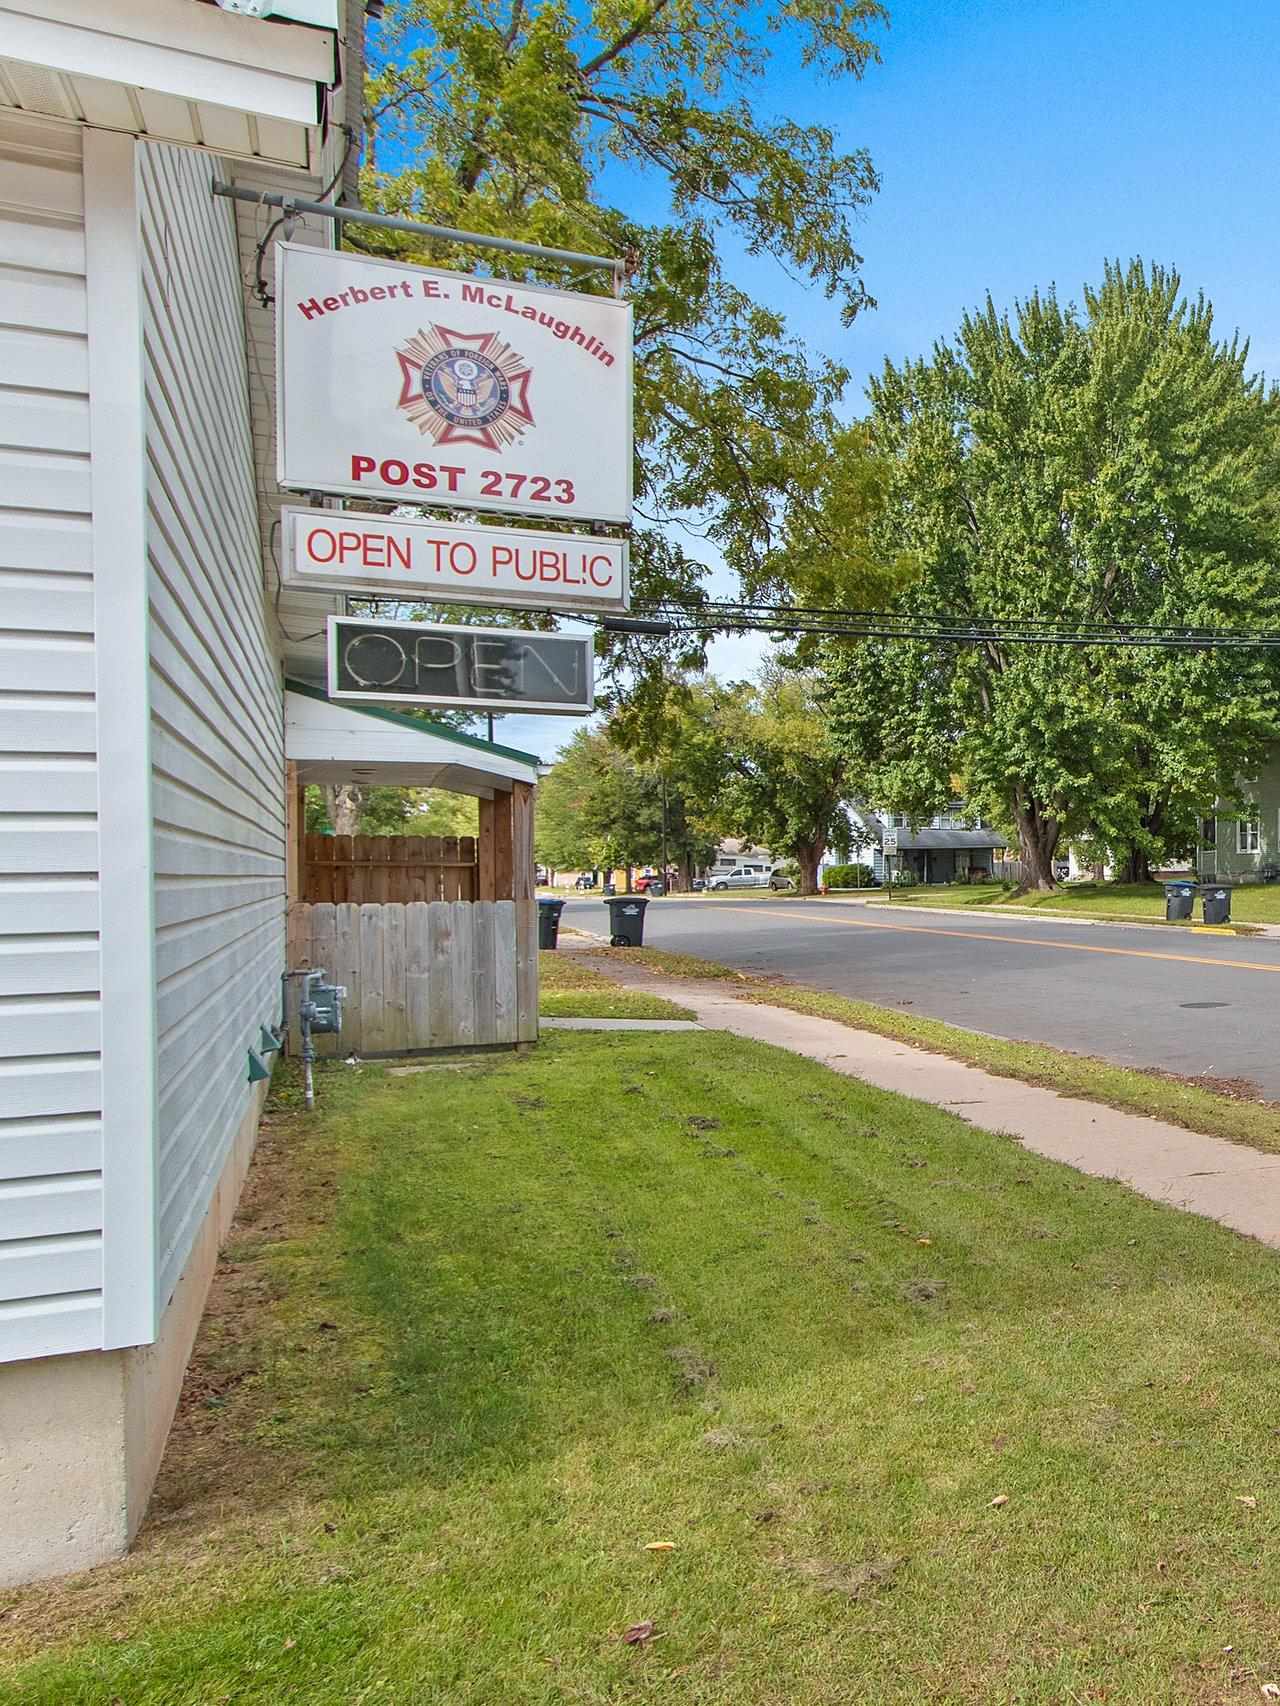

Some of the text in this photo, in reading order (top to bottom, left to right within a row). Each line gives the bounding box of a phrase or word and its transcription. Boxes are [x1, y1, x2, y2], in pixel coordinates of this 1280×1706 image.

[297, 280, 616, 367] Herbert E. McLaughlin
[351, 455, 576, 504] POST 2723
[307, 528, 411, 569] OPEN
[426, 539, 477, 575] TO
[344, 633, 578, 696] OPEN
[884, 838, 896, 846] 25
